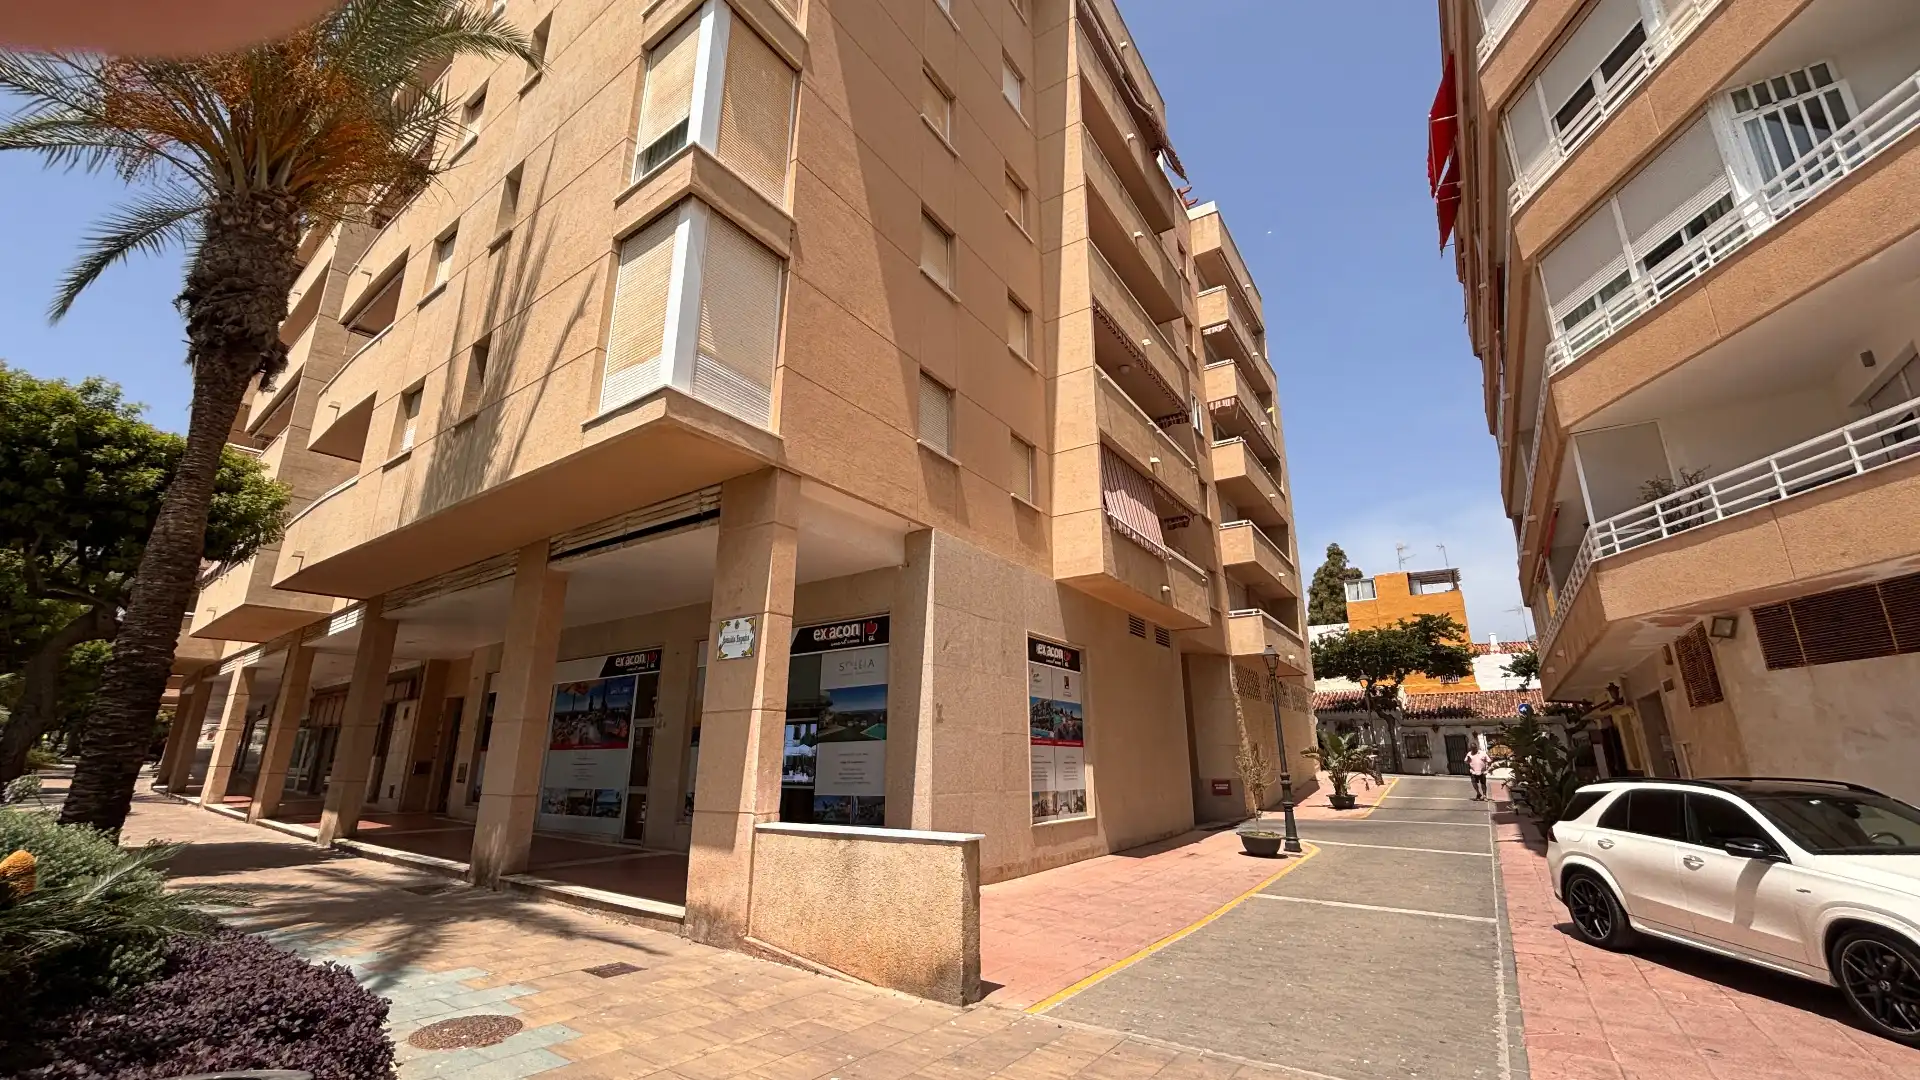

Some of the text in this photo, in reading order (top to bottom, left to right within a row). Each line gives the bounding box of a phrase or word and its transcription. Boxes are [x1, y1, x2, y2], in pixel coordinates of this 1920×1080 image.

[813, 623, 861, 641] exacon
[615, 653, 646, 667] exacon
[1036, 643, 1064, 660] exacon
